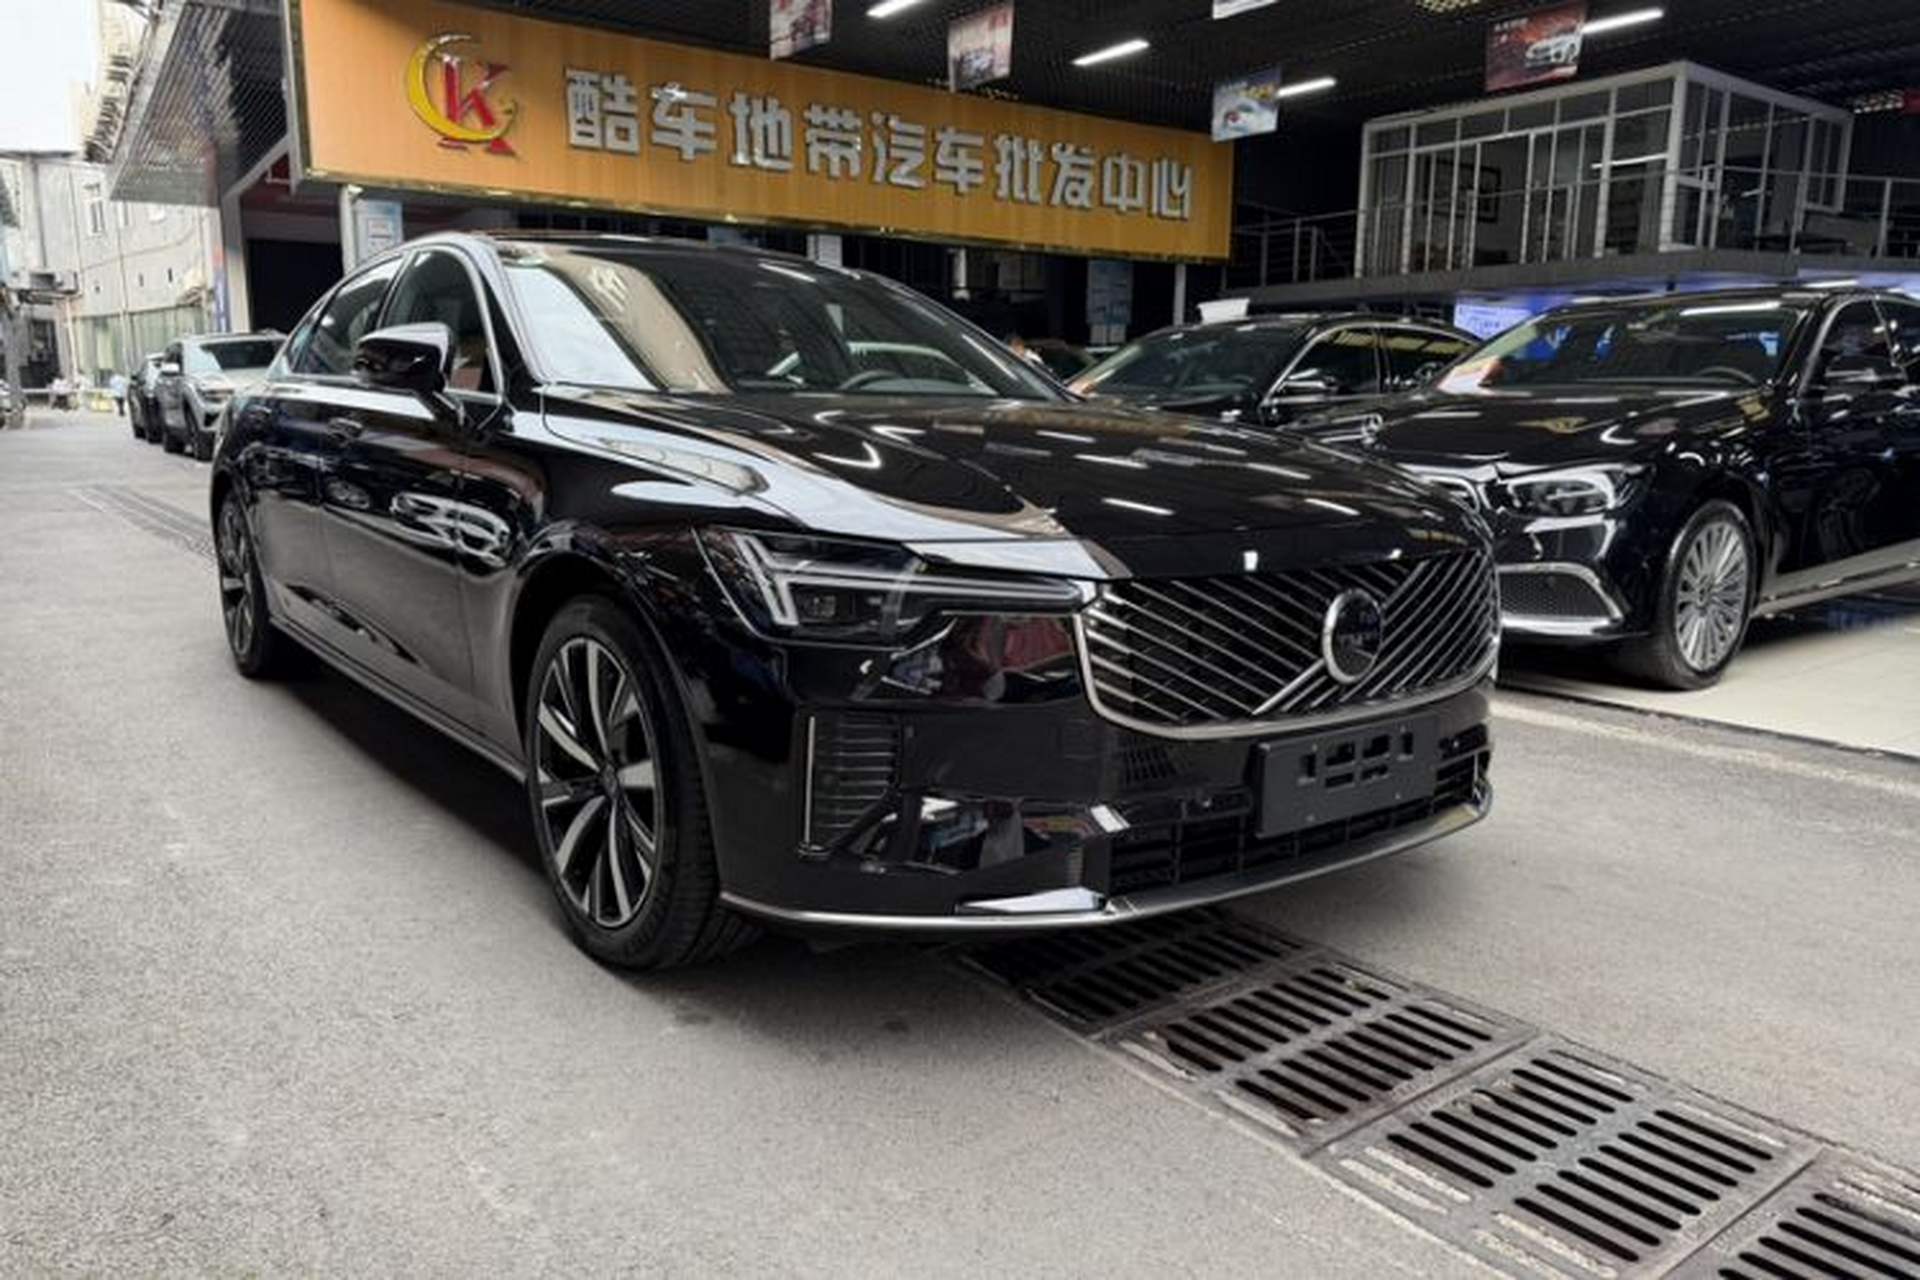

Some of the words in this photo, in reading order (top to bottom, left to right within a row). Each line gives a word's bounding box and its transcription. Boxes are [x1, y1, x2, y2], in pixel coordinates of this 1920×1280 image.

[565, 70, 1192, 219] 酷车地带汽车批发中心
